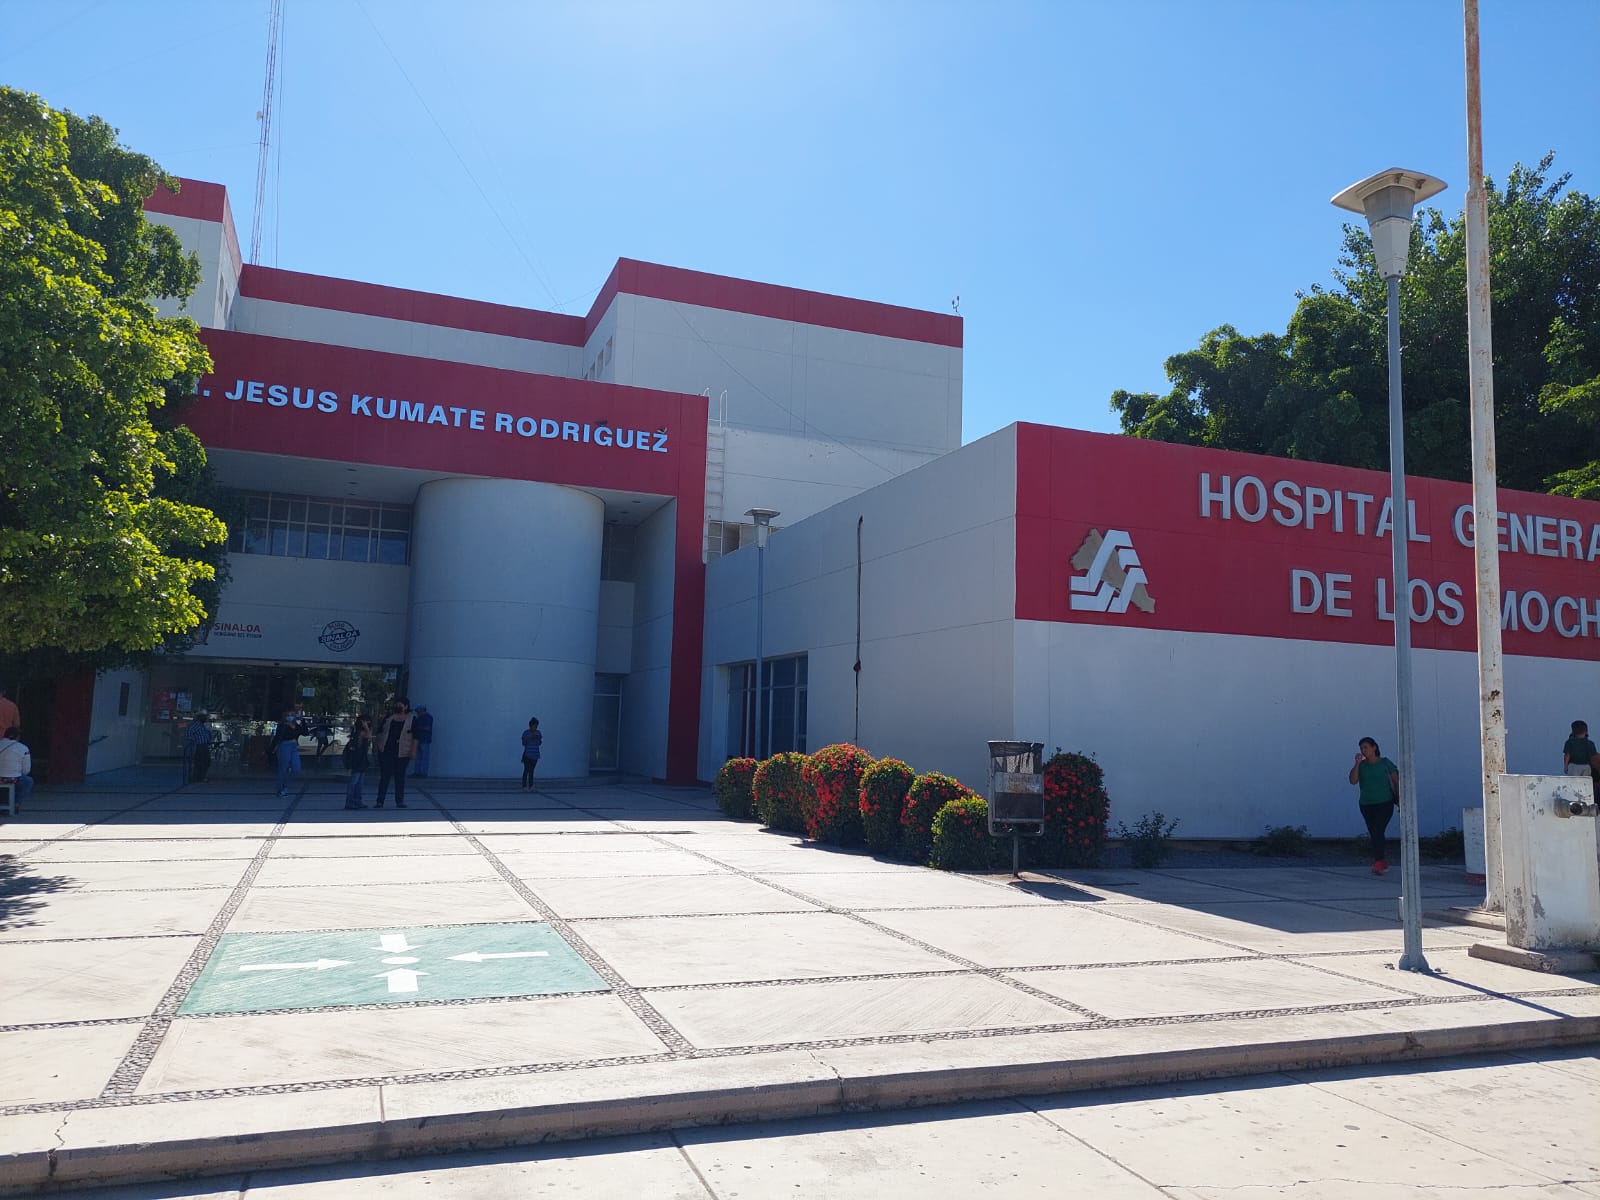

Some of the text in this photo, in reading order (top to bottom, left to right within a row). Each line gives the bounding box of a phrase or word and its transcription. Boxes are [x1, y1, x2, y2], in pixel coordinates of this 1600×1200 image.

[225, 379, 338, 414] JESUS
[351, 393, 486, 431] KUMATE
[495, 412, 669, 454] RODRIGUEZ
[1200, 473, 1430, 542] HOSPITAL
[214, 622, 261, 633] SINALOA
[1290, 568, 1354, 618] DE
[1377, 578, 1464, 626] LOS
